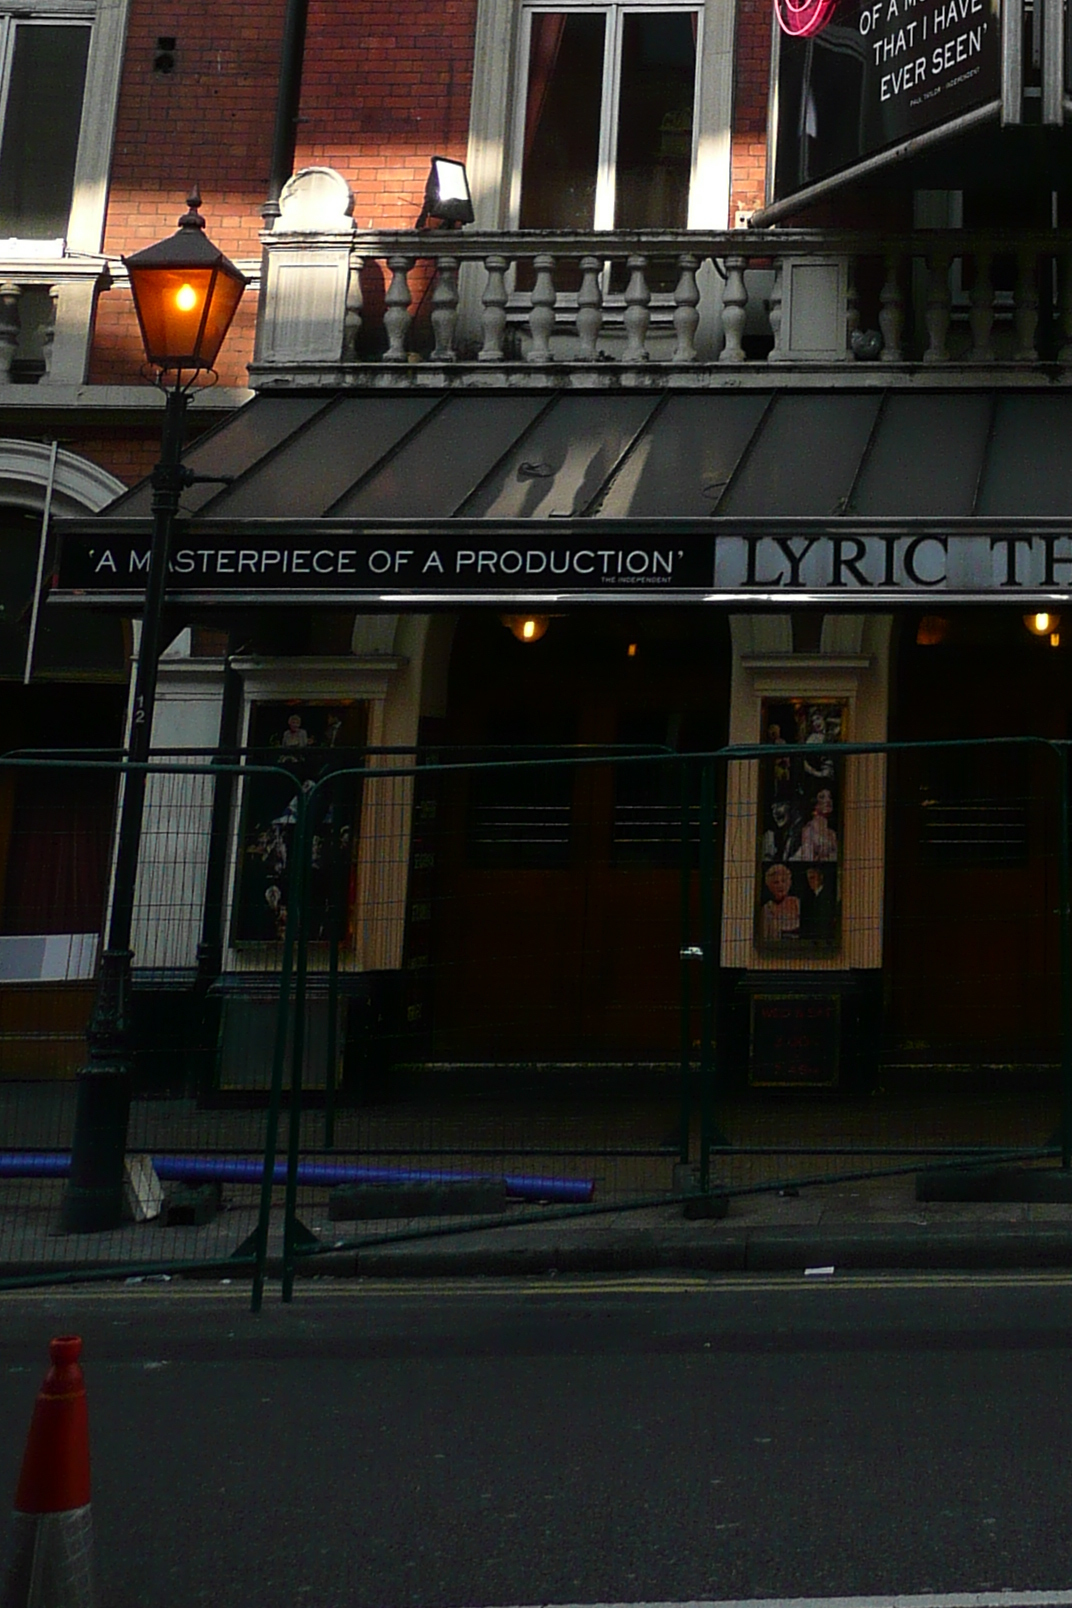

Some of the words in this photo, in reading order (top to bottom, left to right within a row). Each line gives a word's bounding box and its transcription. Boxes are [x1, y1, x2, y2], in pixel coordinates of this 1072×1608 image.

[859, 2, 883, 35] OF
[872, 20, 918, 66] THAT
[922, 15, 928, 41] I
[880, 56, 927, 102] EVER
[368, 549, 414, 574] OF
[421, 549, 446, 574] A
[601, 576, 616, 584] THE
[617, 576, 672, 584] INDEPENDENT
[740, 533, 949, 588] LYRIC
